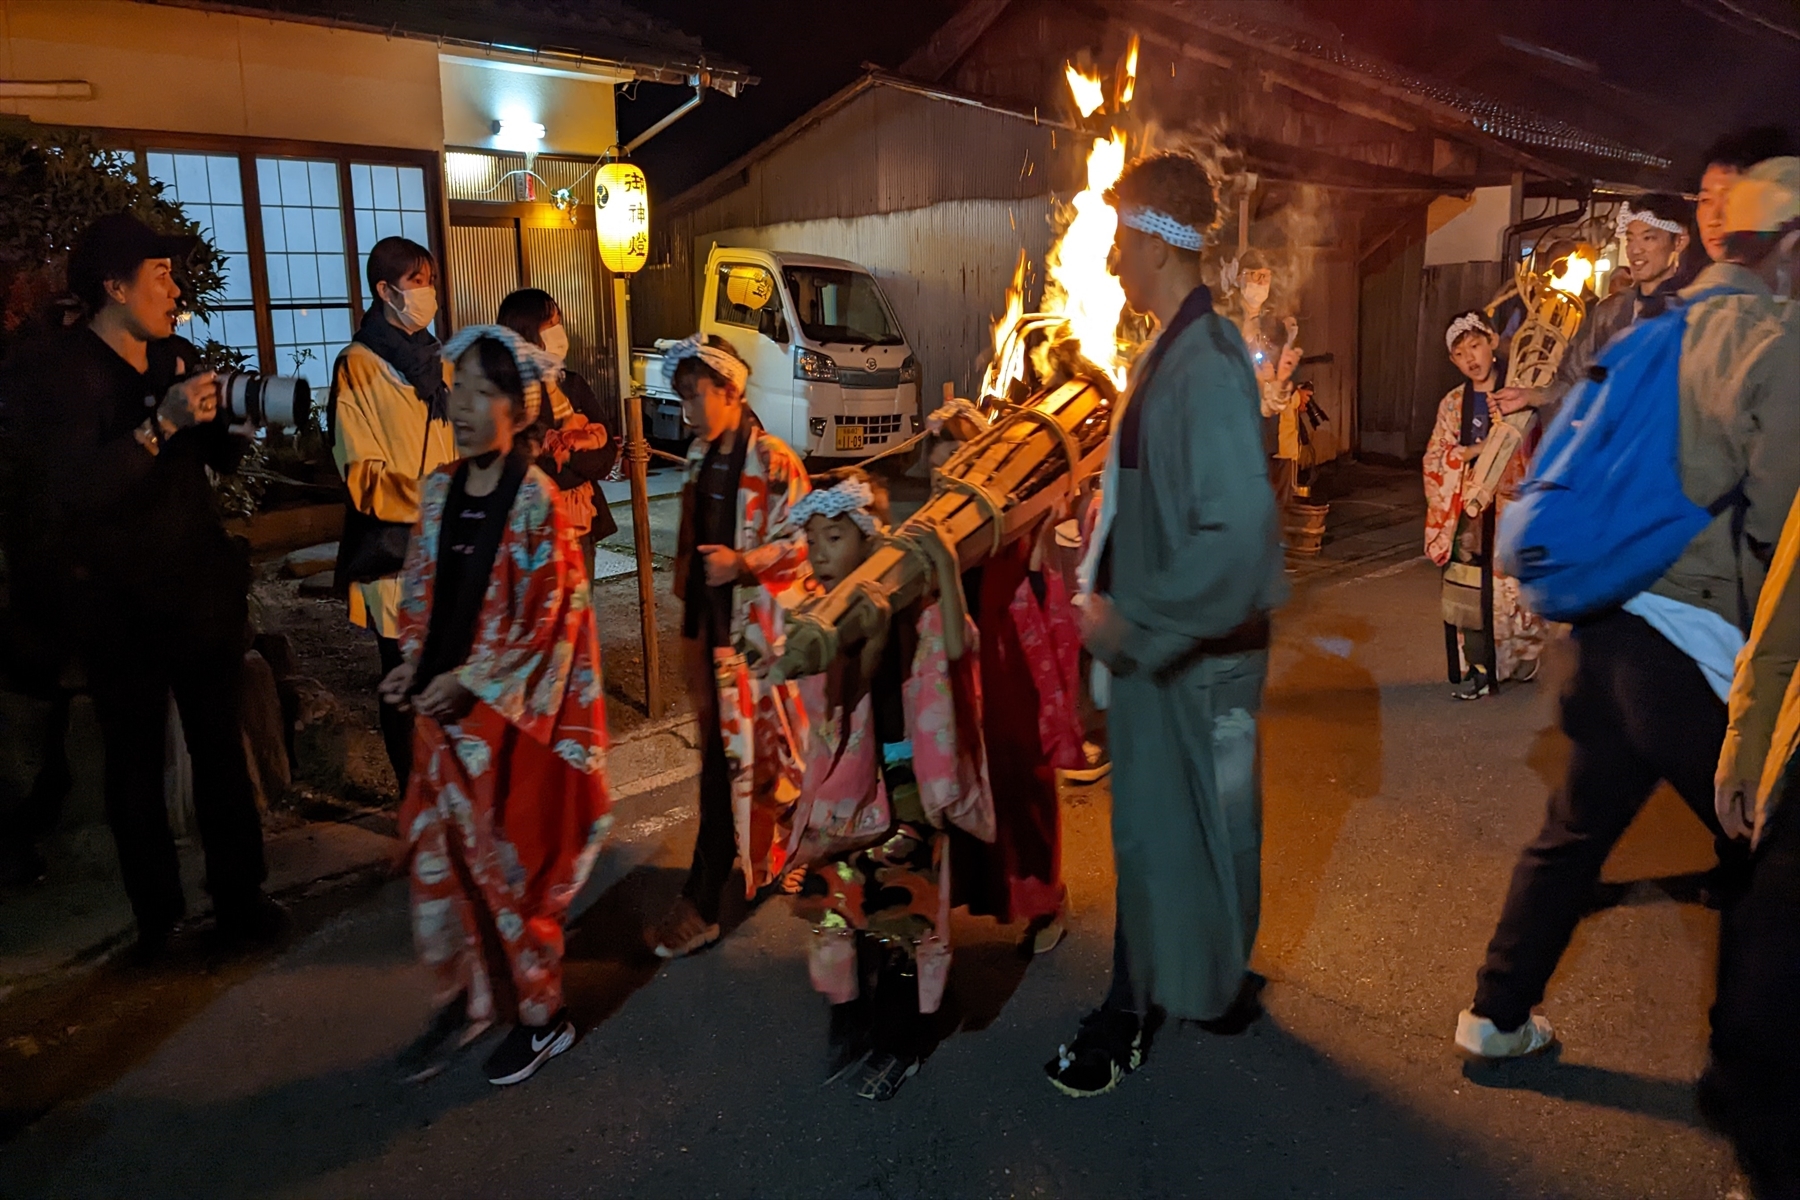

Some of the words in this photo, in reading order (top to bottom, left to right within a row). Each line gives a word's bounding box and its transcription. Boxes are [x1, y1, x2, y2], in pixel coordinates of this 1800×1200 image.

[624, 171, 647, 257] 御神燈
[843, 435, 862, 448] 11-09
